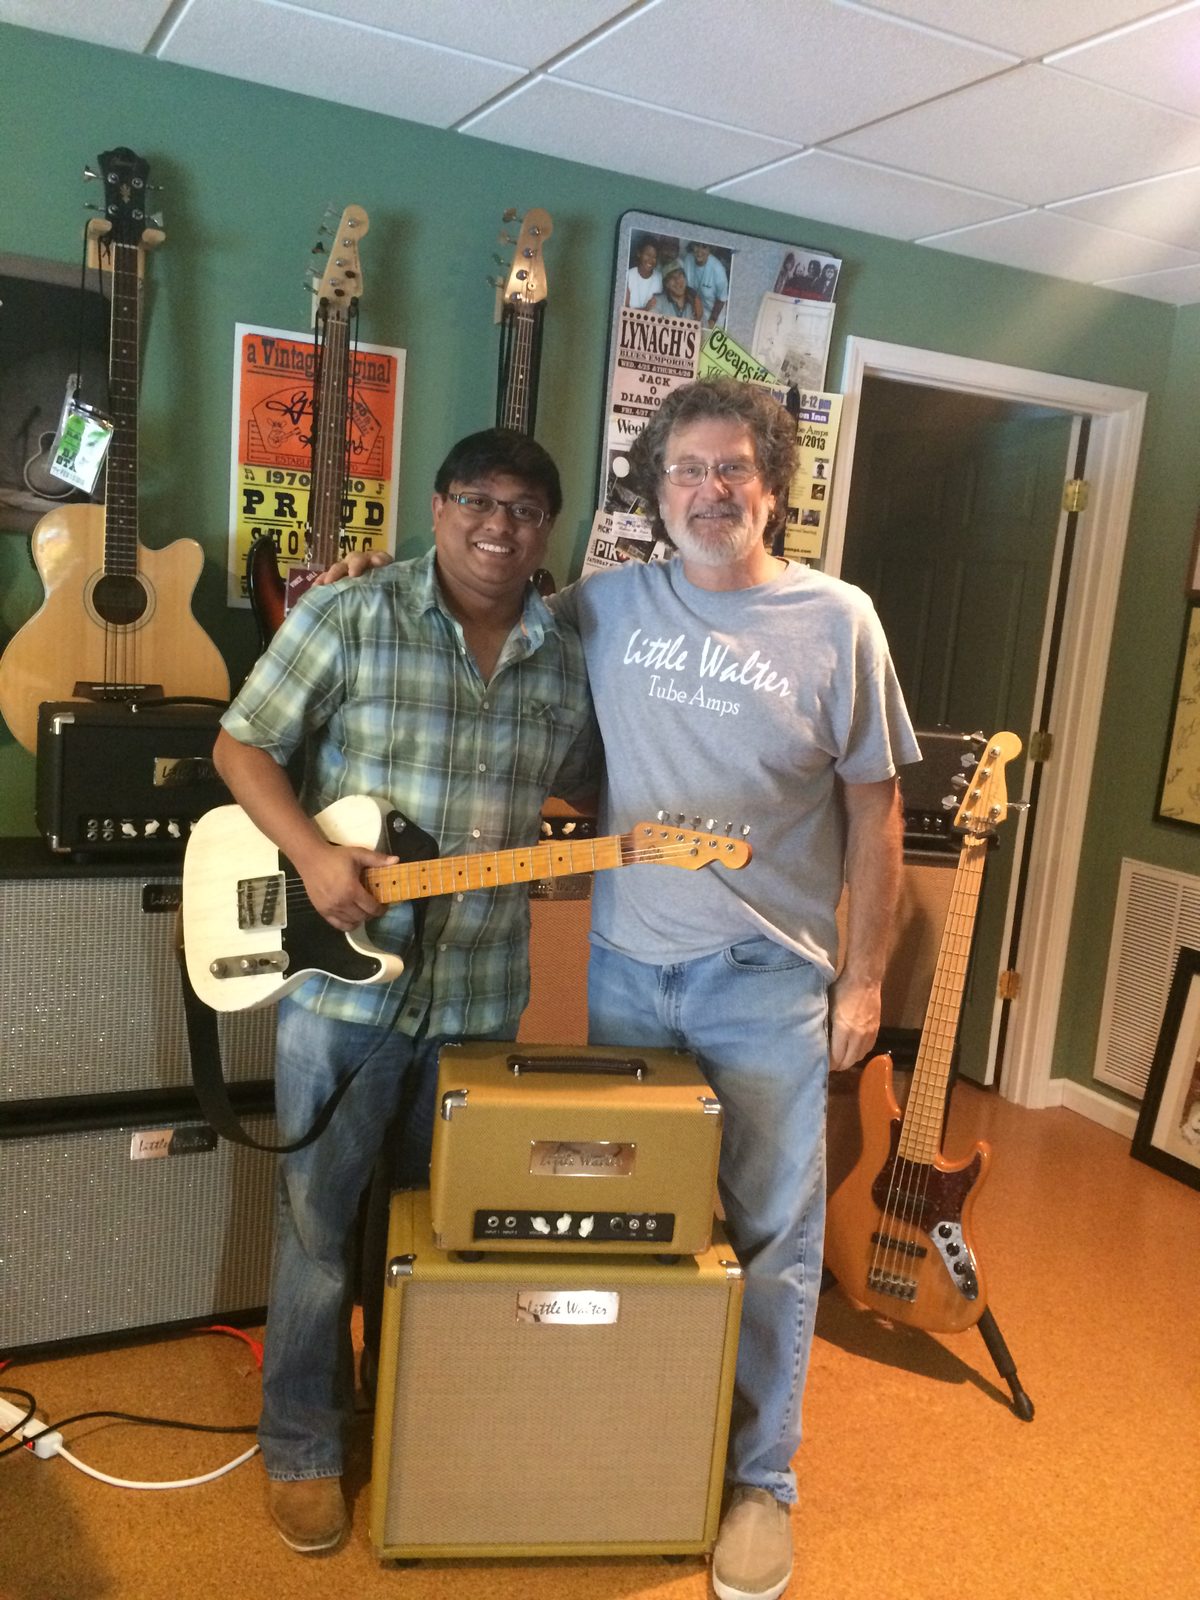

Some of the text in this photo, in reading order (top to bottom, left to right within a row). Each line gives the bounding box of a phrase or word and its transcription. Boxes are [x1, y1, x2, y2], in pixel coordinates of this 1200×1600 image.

[620, 320, 696, 359] LYNAGH'S
[247, 337, 391, 385] a Vintag iginal
[620, 350, 694, 368] BLUES EMPORIUM
[639, 373, 671, 387] JACK
[621, 391, 661, 407] DIAMO
[650, 386, 657, 395] O
[266, 469, 311, 487] 1970
[243, 488, 385, 526] PRUD
[623, 628, 791, 698] Little Walter
[648, 674, 741, 717] Tube Amps
[567, 1300, 607, 1315] Water
